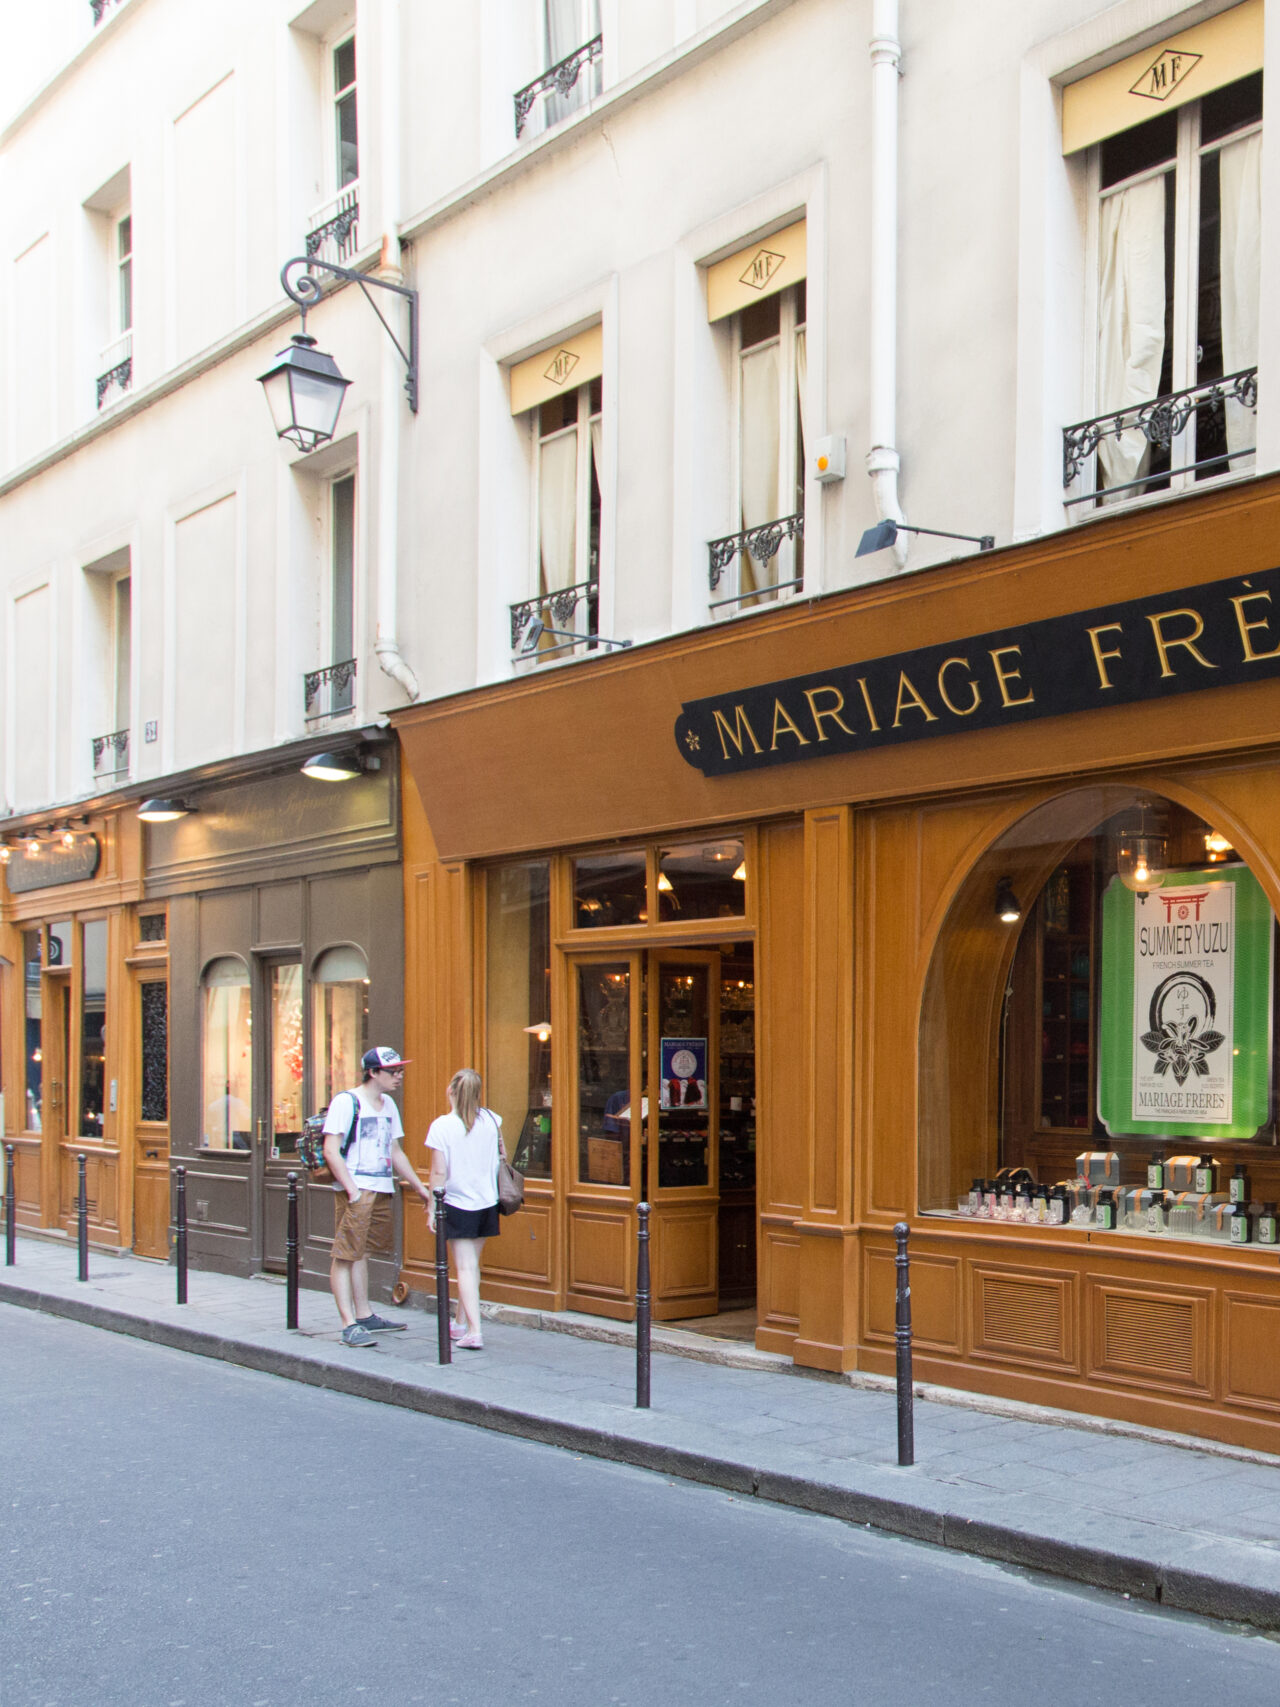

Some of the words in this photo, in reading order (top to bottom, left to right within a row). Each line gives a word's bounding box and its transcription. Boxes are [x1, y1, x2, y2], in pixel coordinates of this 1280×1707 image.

[1150, 56, 1182, 94] MF
[752, 255, 773, 284] MF
[553, 355, 570, 380] MF
[712, 645, 1034, 760] MARIAGE
[1140, 925, 1192, 957] SUMMER
[1195, 922, 1228, 953] YUZU
[1152, 962, 1176, 970] FRENCH
[1177, 960, 1201, 969] SUMMER
[1203, 960, 1214, 968] TEA
[1176, 986, 1190, 1019] ゆず
[1139, 1092, 1183, 1108] MARIAGE
[1186, 1088, 1225, 1109] FRÈRES
